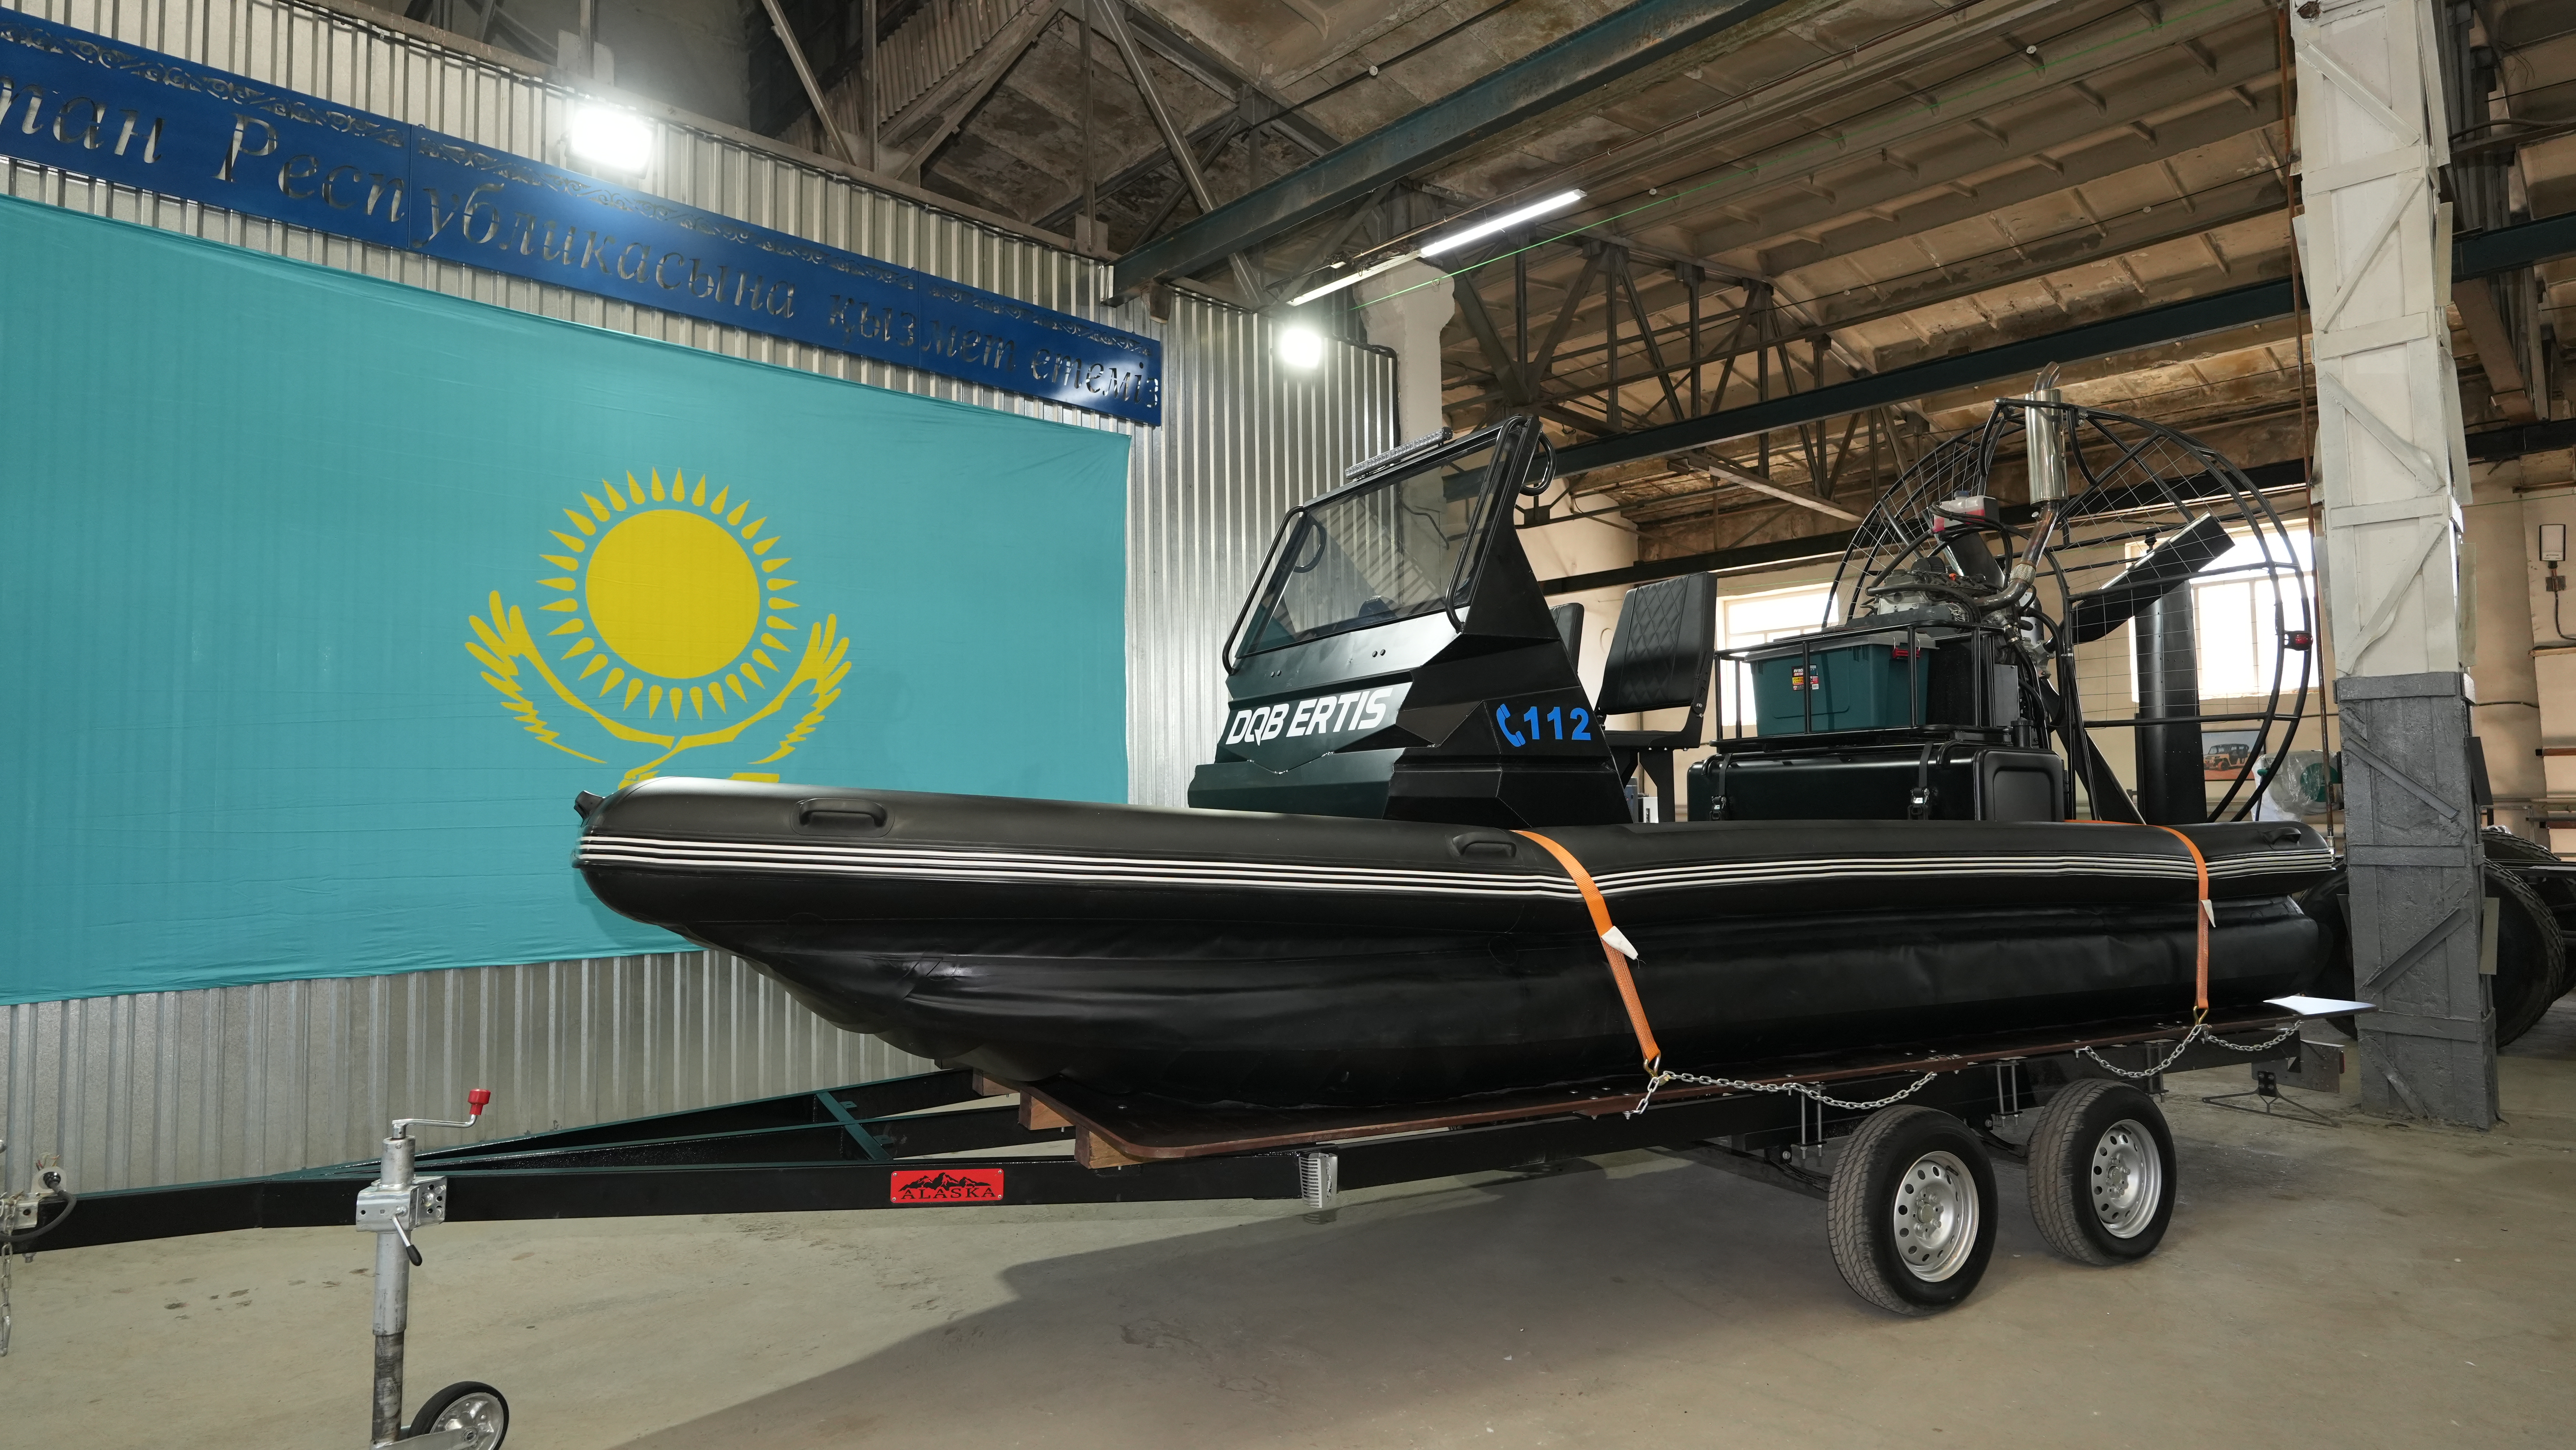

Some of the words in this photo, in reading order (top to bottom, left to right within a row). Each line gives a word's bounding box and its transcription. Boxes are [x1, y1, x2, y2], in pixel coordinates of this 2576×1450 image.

[211, 113, 795, 318] Республикасына
[830, 295, 1016, 371] қызмет
[1031, 349, 1158, 408] етеміз
[1226, 704, 1289, 746] DQB
[1286, 688, 1393, 737] ERTIS
[1524, 706, 1591, 740] 112
[901, 1188, 995, 1199] ALASKA
